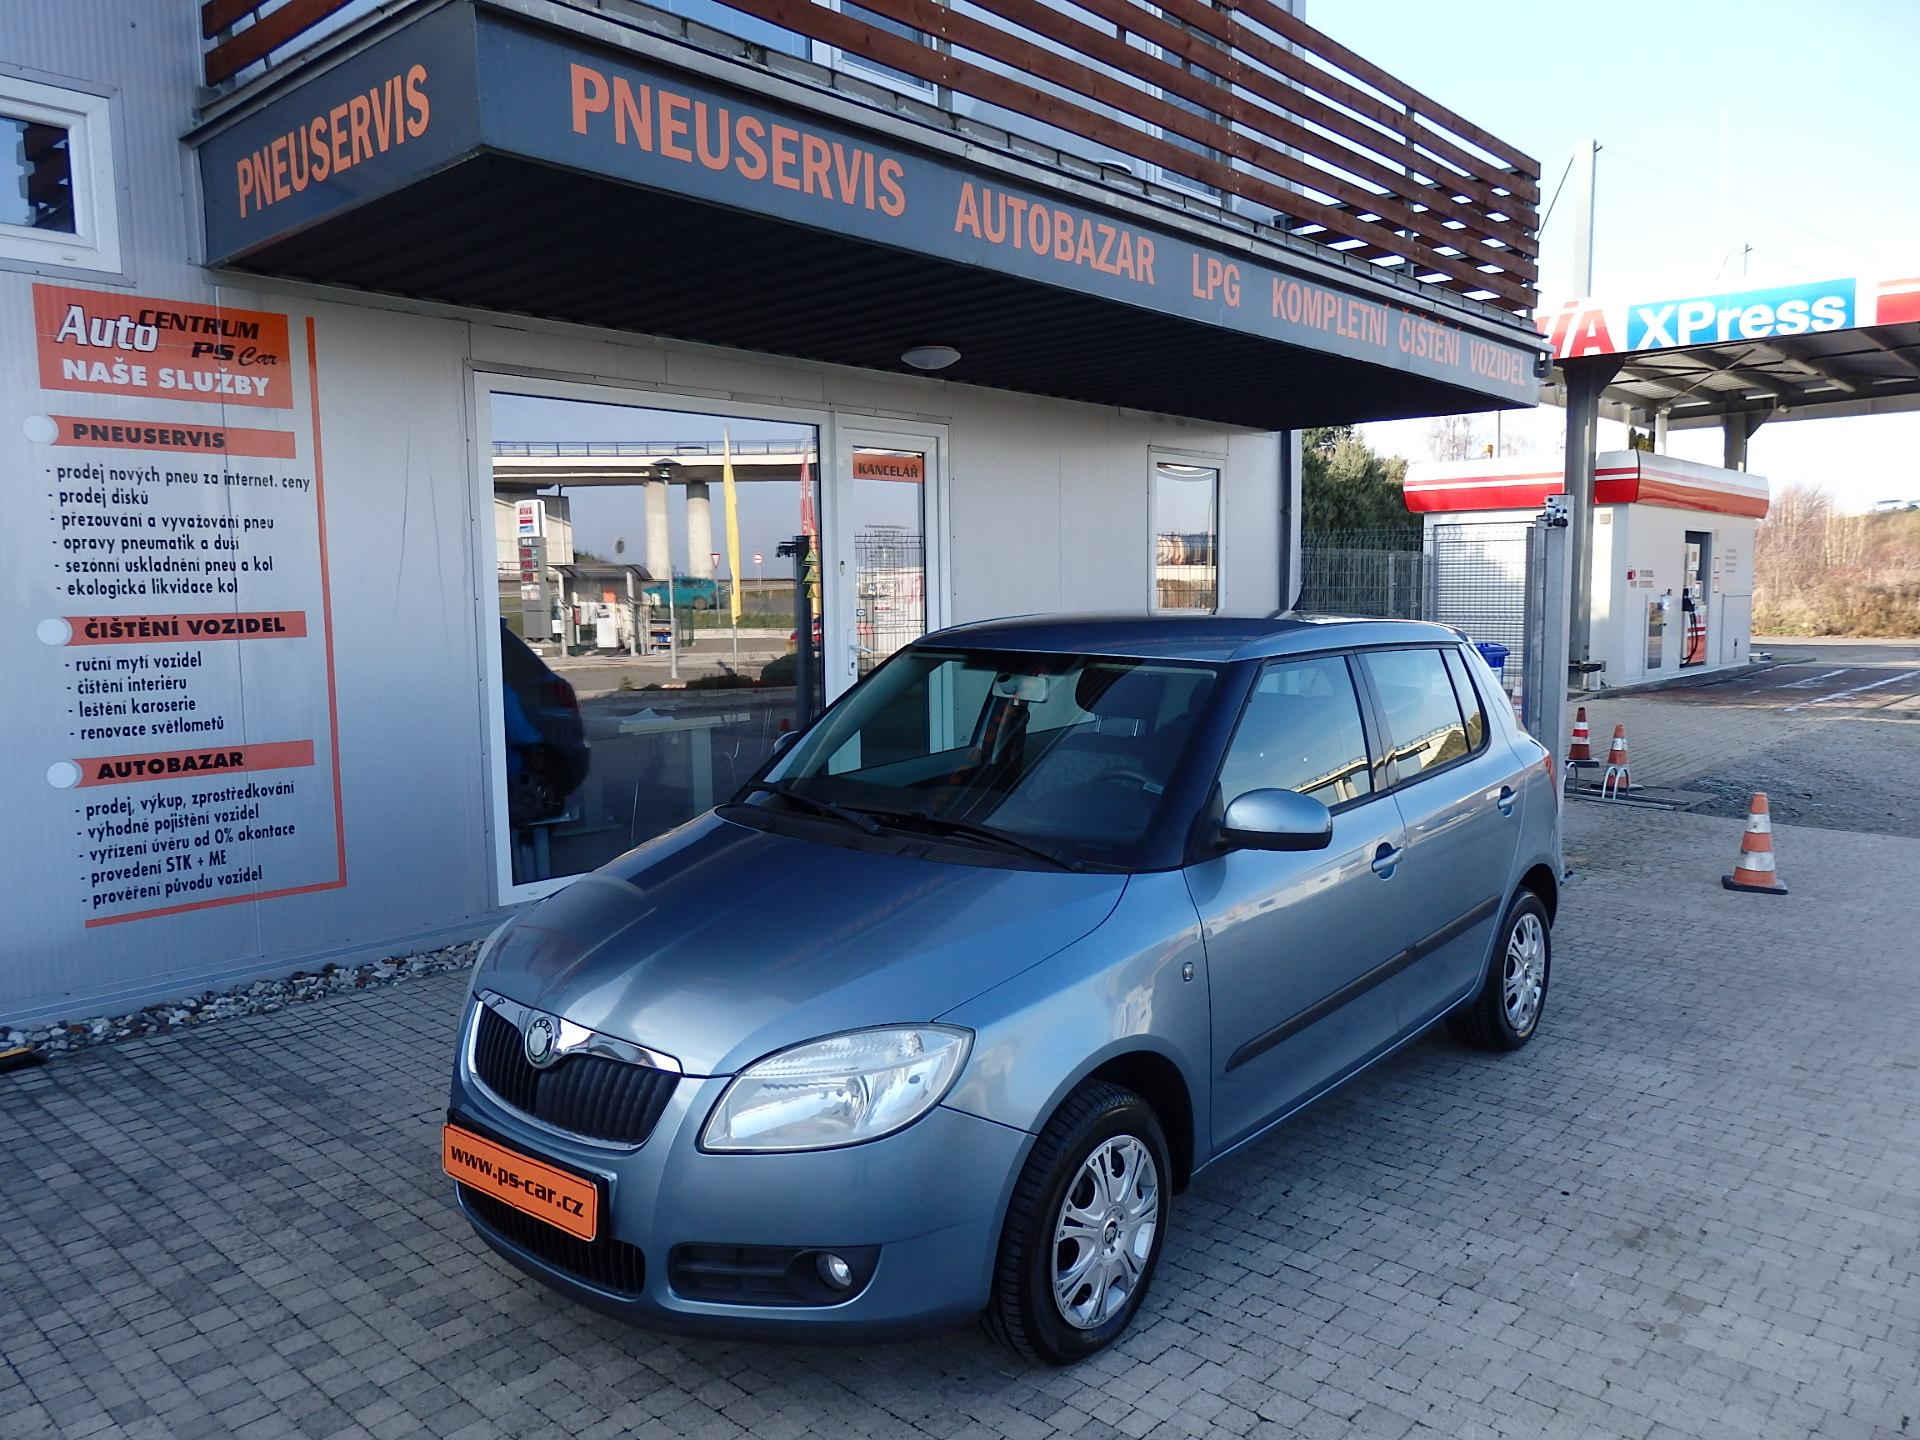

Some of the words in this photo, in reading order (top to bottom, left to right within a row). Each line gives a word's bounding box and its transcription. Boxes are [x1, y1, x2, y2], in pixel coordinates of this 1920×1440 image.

[236, 64, 430, 219] PNEUSERVIS
[569, 63, 906, 217] PNEUSERVIS
[954, 182, 1156, 285] AUTOBAZAR
[1192, 253, 1241, 308] LPG
[1272, 279, 1388, 348] KOMPLETNÍ
[1399, 308, 1461, 367] ČIŠTĚNÍ
[1470, 339, 1526, 387] VOZIDEL
[55, 303, 158, 352] Auto
[139, 309, 259, 339] CENTRUM
[1631, 296, 1847, 349] XPress
[191, 342, 235, 361] PS
[238, 346, 278, 366] Car
[62, 356, 147, 386] NAŠE
[159, 366, 270, 397] SLUŽBY
[73, 424, 225, 448] PNEUSERVIS
[57, 463, 104, 484] prodej
[109, 466, 160, 485] nových
[166, 471, 198, 486] pneu
[204, 473, 218, 485] za
[282, 477, 310, 492] ceny
[858, 463, 918, 478] KANCELÁŘ
[60, 486, 106, 508] prodej
[147, 516, 156, 527] a
[162, 514, 239, 532] vyvažování
[244, 517, 274, 532] pneu
[63, 538, 115, 553] opravy
[121, 533, 195, 553] pneumatik
[201, 539, 209, 550] a
[66, 557, 120, 573] sezónní
[125, 555, 200, 573] uskladnění
[205, 561, 236, 575] pneu
[241, 561, 249, 572] a
[253, 555, 273, 572] kol
[68, 578, 146, 599] ekologická
[152, 577, 213, 595] likvidace
[218, 577, 238, 594] kol
[85, 616, 179, 639] ČIŠTĚNÍ
[187, 617, 286, 635] VOZIDEL
[76, 656, 111, 671] ruční
[116, 654, 148, 674] mytí
[154, 650, 202, 668] vozidel
[78, 678, 123, 694] čištění
[128, 675, 187, 692] interiéru
[79, 700, 126, 717] leštění
[131, 695, 196, 714] karoserie
[81, 725, 146, 740] renovace
[152, 716, 224, 735] světlometů
[97, 751, 244, 780] AUTOBAZAR
[86, 796, 134, 820] prodej,
[140, 792, 186, 813] výkup,
[192, 780, 295, 808] zprostředkování
[87, 818, 149, 842] výhodné
[154, 811, 210, 834] pojištění
[214, 803, 259, 823] vozidel
[90, 841, 147, 864] vyřízení
[194, 830, 210, 847] od
[215, 827, 233, 844] 0%
[238, 824, 296, 841] akontace
[91, 859, 161, 888] provedení
[166, 853, 192, 873] STK
[209, 849, 227, 867] ME
[92, 881, 160, 909] prověření
[165, 873, 213, 898] původu
[218, 864, 263, 886] vozidel
[451, 1145, 584, 1218] www.ps-car.cz
